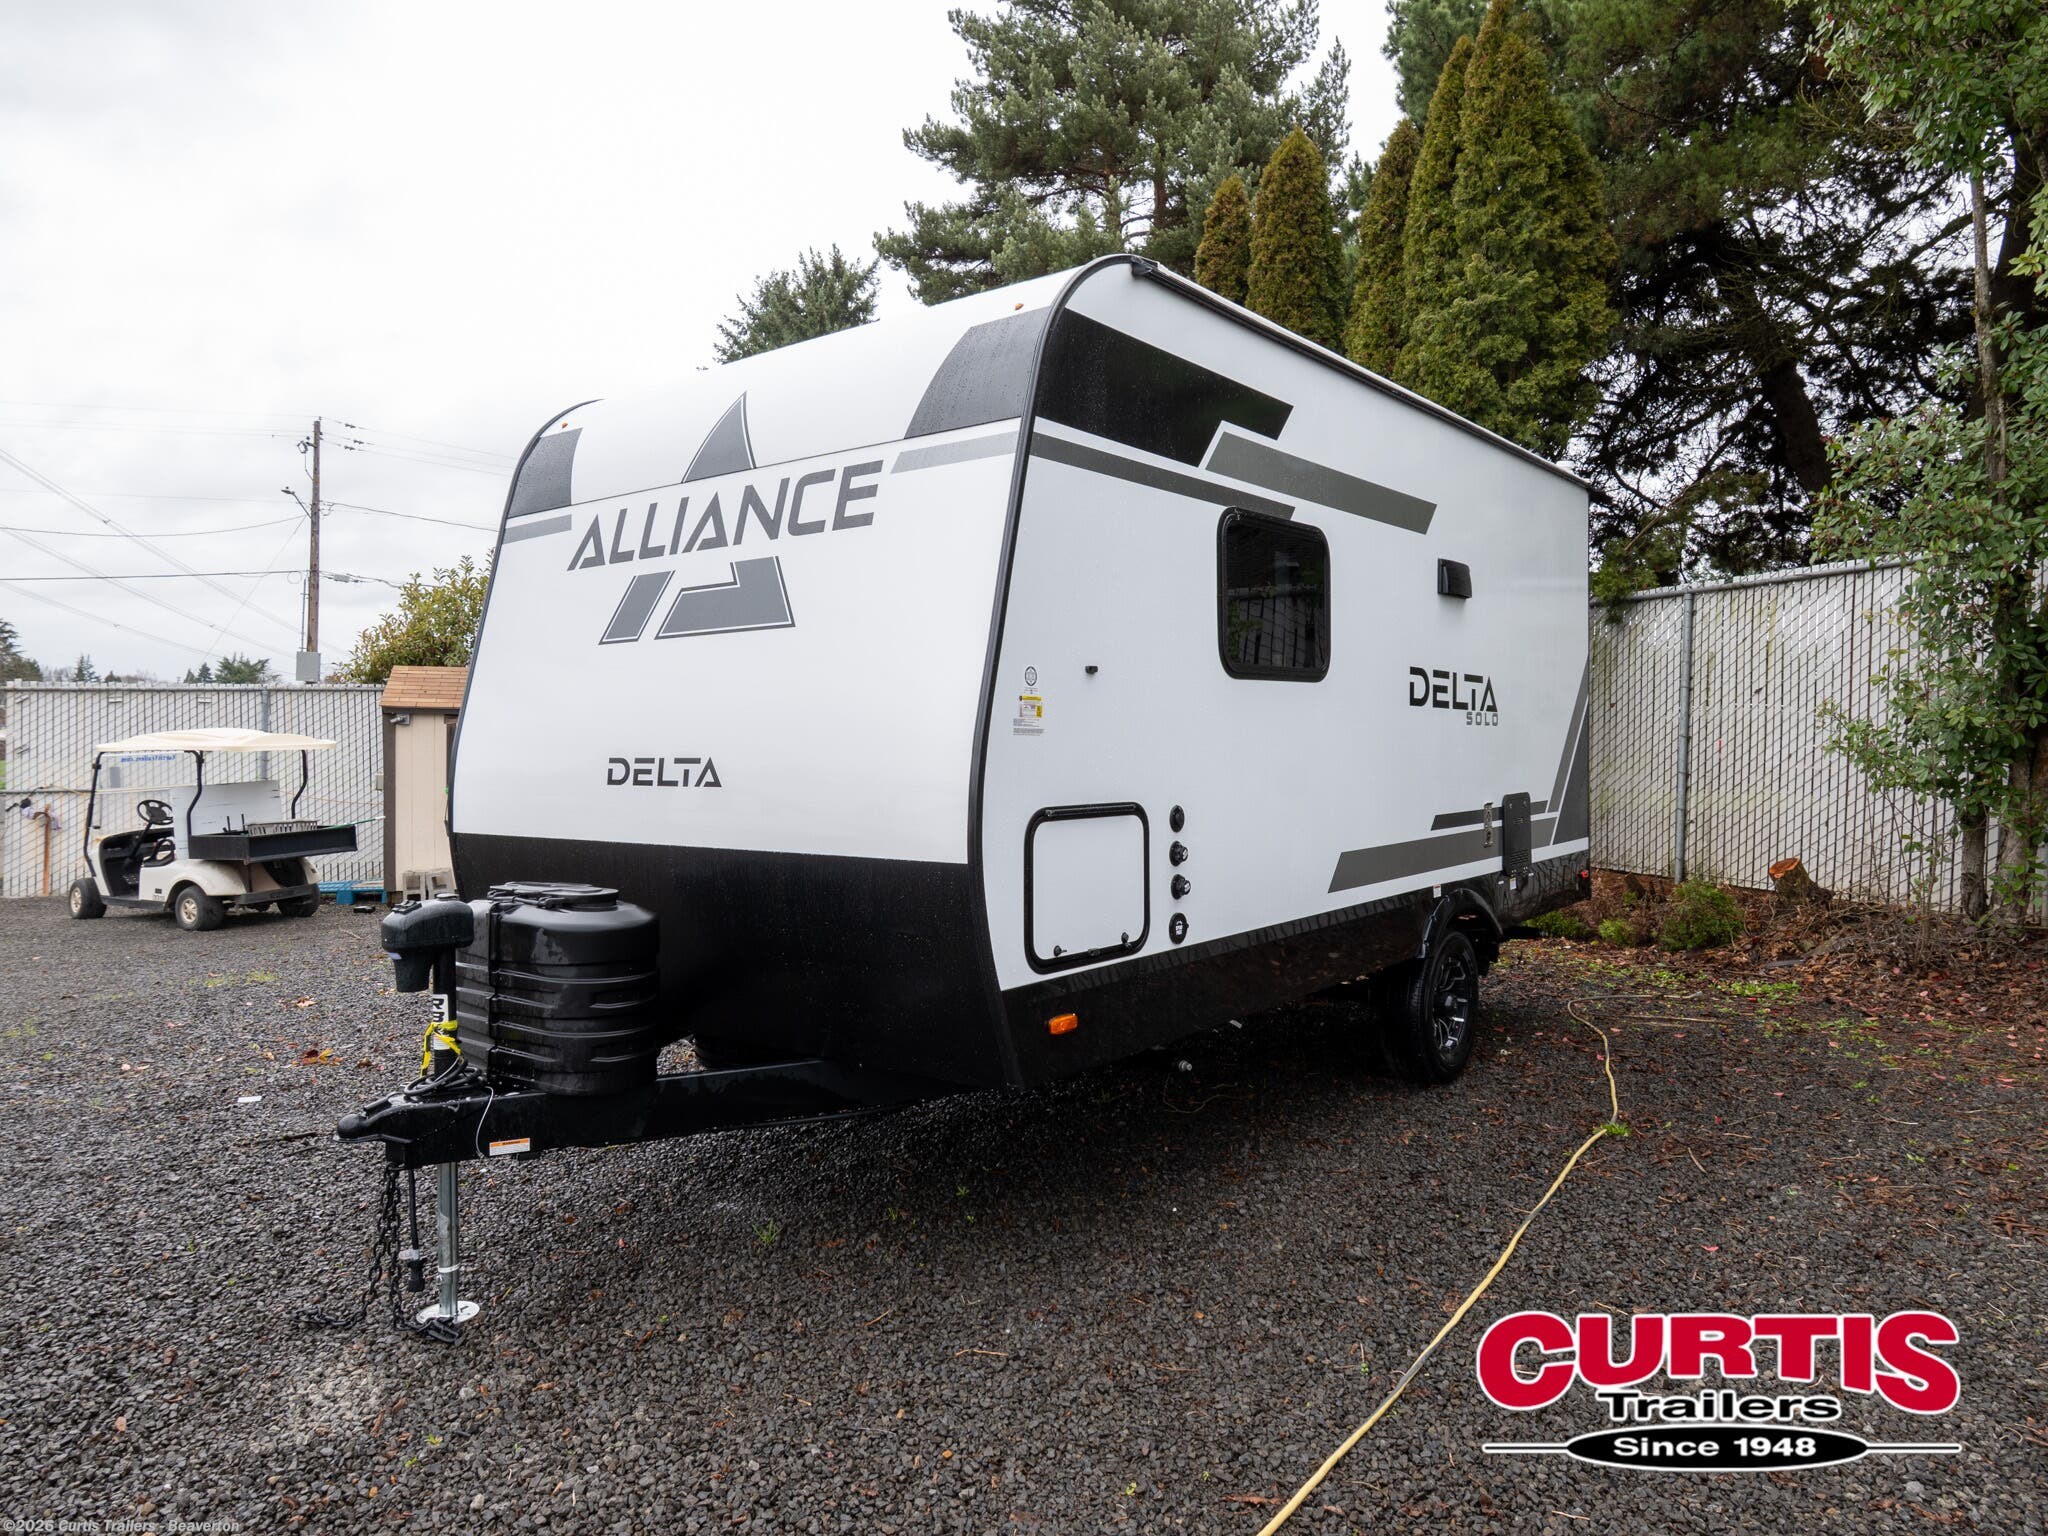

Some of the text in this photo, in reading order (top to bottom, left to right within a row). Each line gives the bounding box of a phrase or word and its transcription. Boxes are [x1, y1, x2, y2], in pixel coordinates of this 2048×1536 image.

[567, 459, 884, 572] ALLIANCE
[1409, 666, 1498, 712] DELTA
[1466, 711, 1499, 727] SOLO
[607, 756, 722, 788] DELTA
